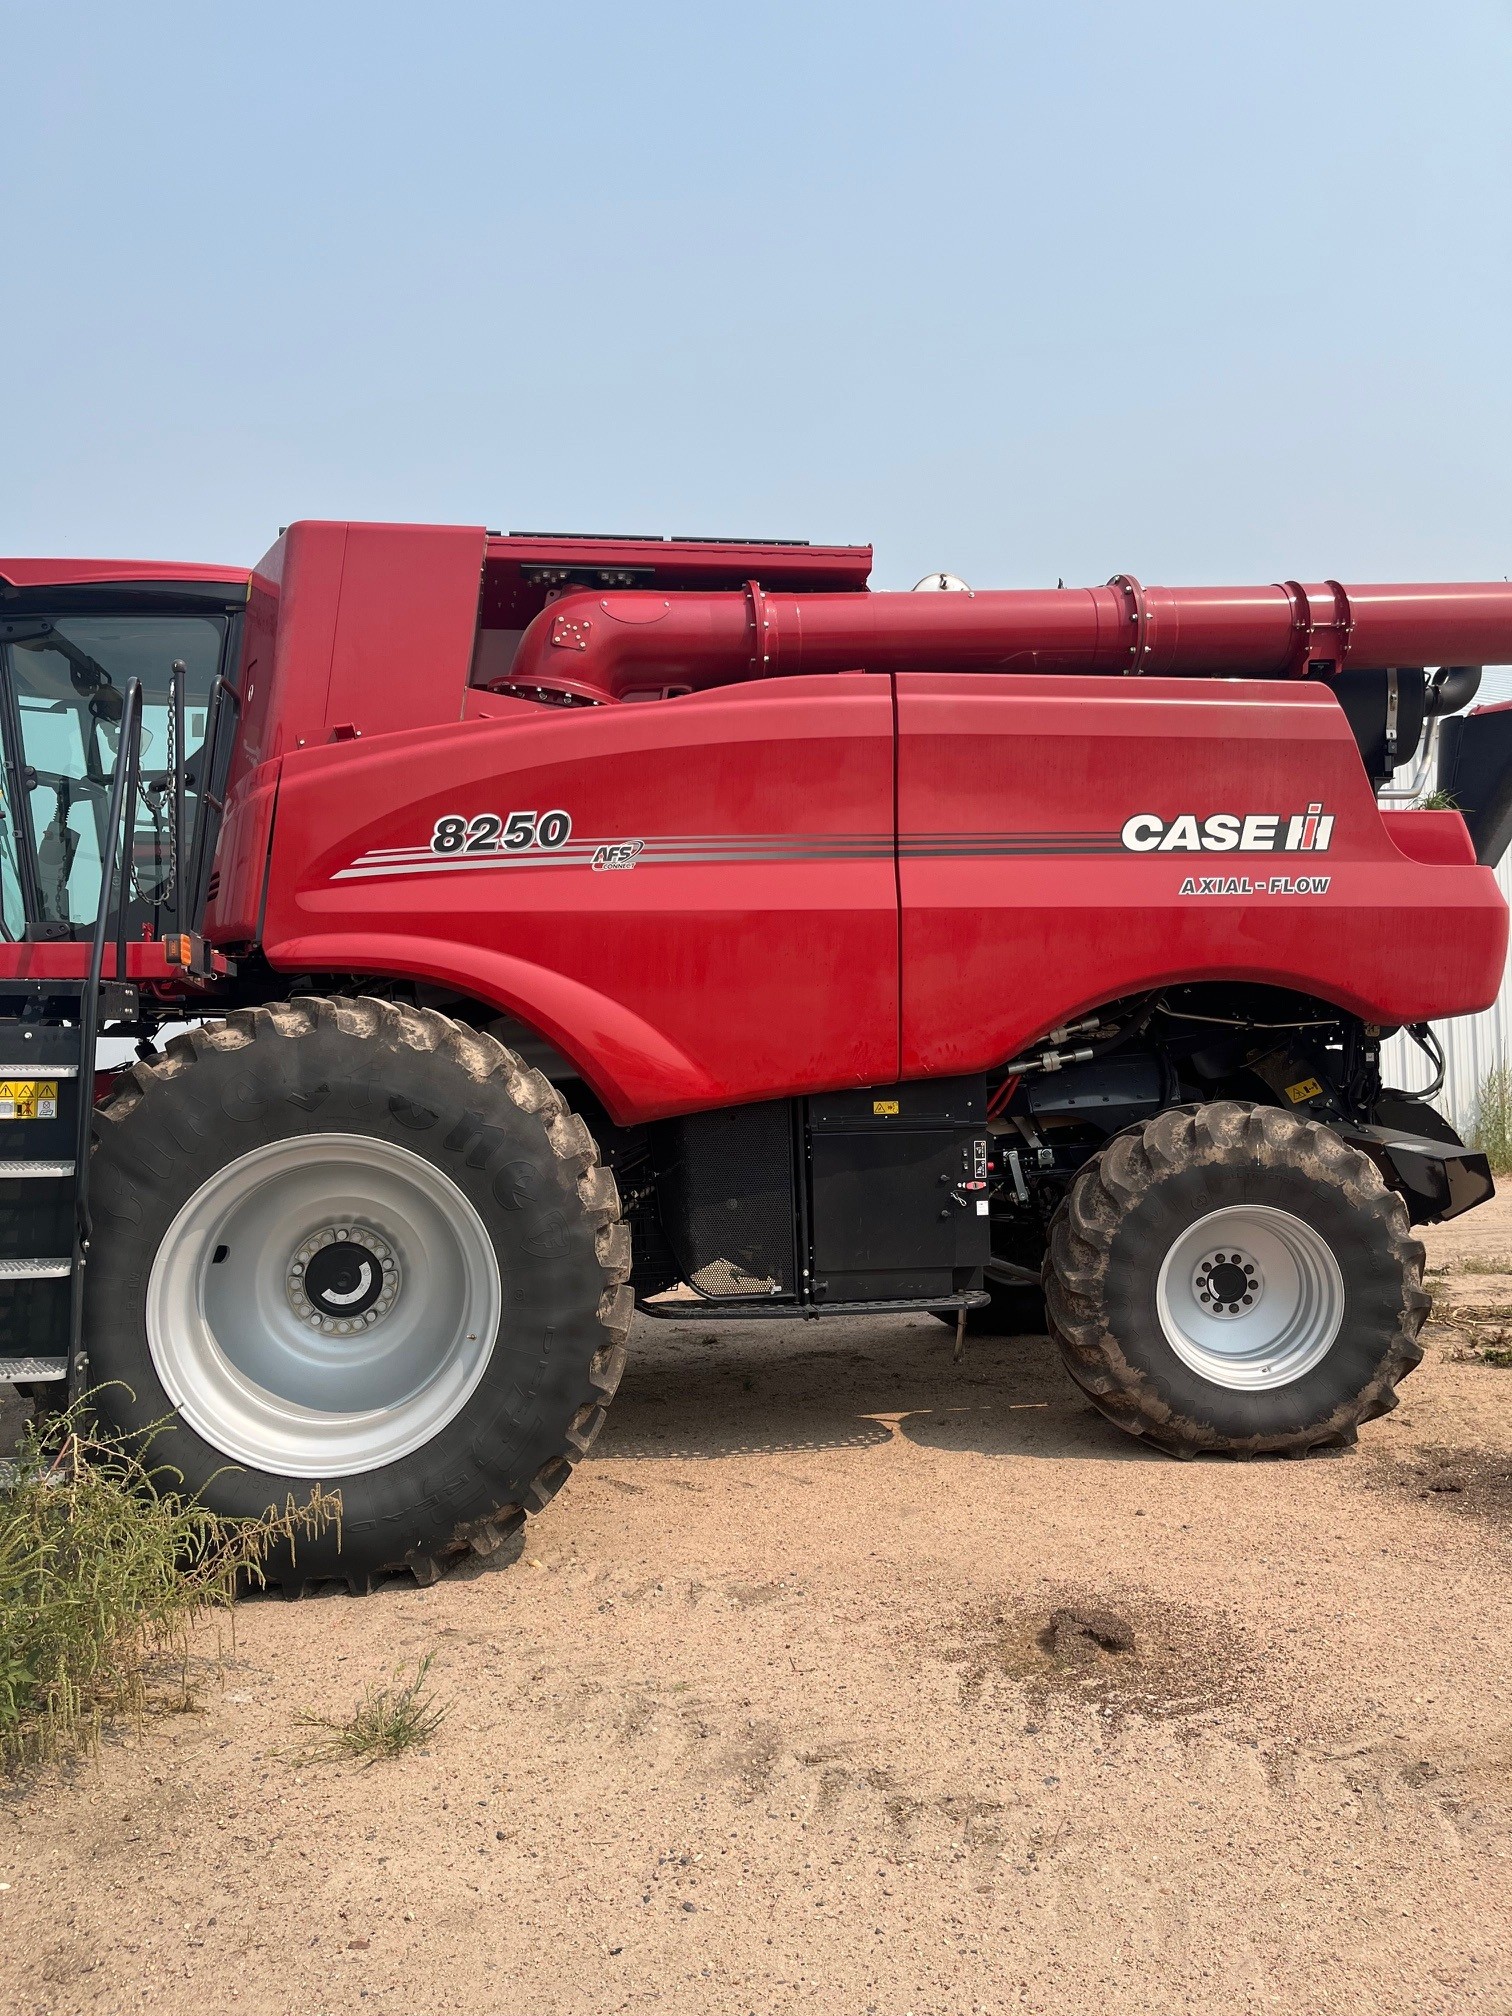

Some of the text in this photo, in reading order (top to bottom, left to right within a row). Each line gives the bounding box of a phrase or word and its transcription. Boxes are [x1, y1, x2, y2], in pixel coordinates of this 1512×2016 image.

[430, 809, 573, 855] 8250
[1121, 813, 1279, 852] CASE
[591, 845, 634, 864] AFS
[602, 862, 637, 870] CONNECT
[103, 1064, 545, 1226] Firestone
